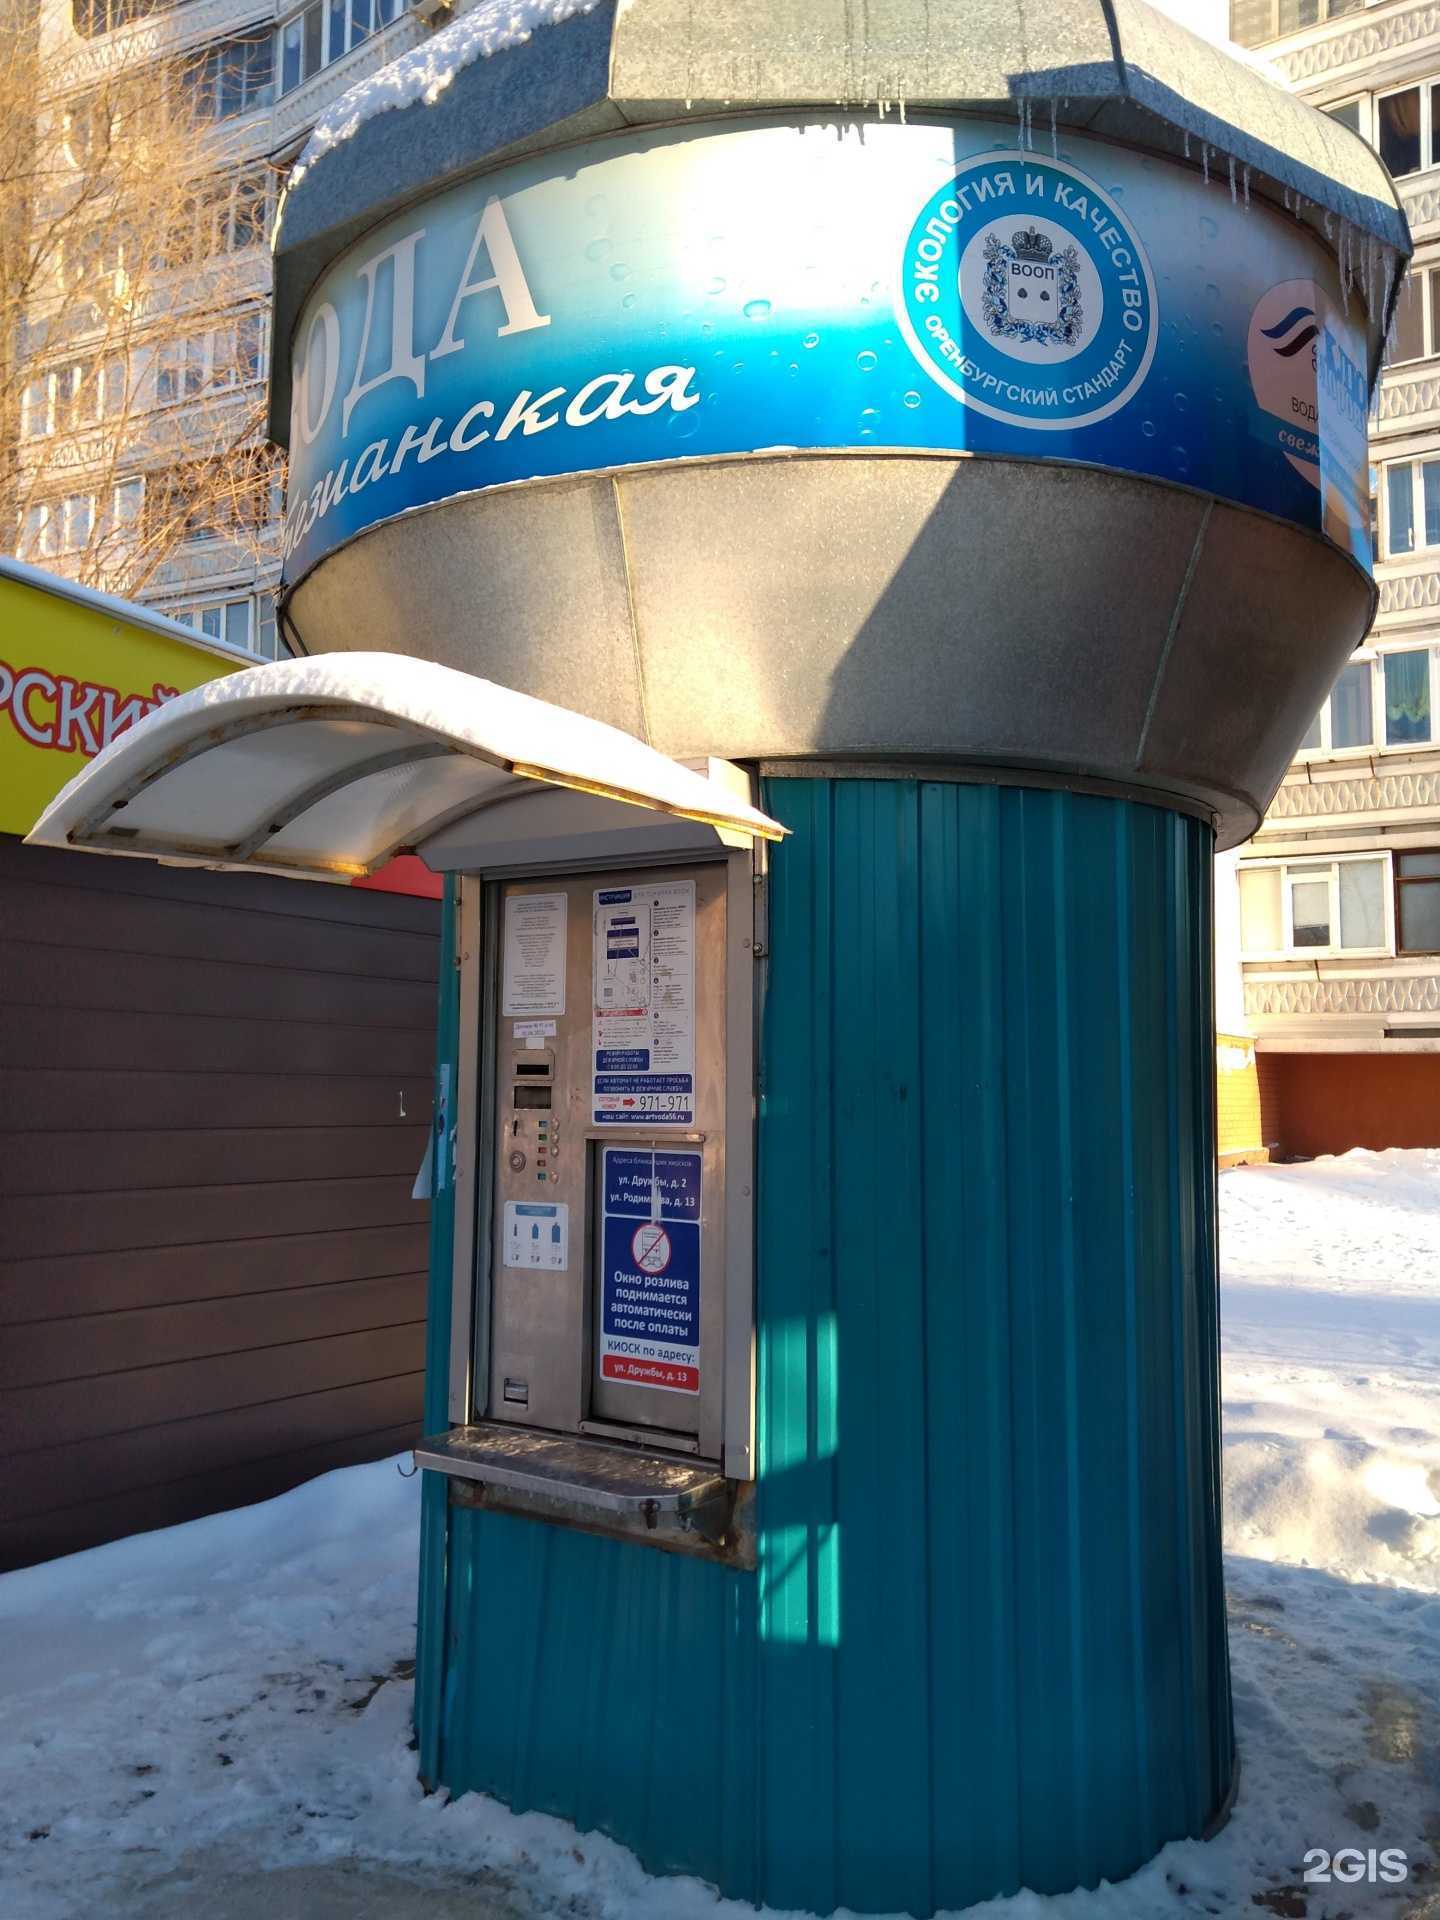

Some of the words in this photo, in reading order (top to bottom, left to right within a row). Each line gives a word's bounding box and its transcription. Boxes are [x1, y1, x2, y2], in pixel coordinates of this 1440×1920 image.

[913, 171, 1016, 304] ЭКОЛОГИЯ
[1025, 173, 1044, 197] И
[1053, 181, 1143, 332] КАЧЕСТВО
[1010, 262, 1055, 281] ВООП
[291, 194, 552, 446] ОДА
[925, 315, 1059, 406] ОРЕНБУРГСКИЙ
[1062, 339, 1134, 405] СТАНДАРТ
[1278, 429, 1320, 457] свеж
[283, 363, 700, 560] езианская
[639, 1095, 689, 1111] 971-971
[618, 1176, 630, 1186] ул.
[681, 1178, 687, 1188] 2
[610, 1193, 622, 1203] ул.
[685, 1197, 695, 1207] 13
[614, 1270, 642, 1285] Окно
[644, 1276, 690, 1290] розлива
[615, 1287, 688, 1305] поднимается
[610, 1302, 693, 1322] автоматически
[614, 1318, 646, 1331] после
[647, 1322, 689, 1337] оплаты
[607, 1339, 641, 1354] КИОСК
[643, 1346, 656, 1357] по
[657, 1348, 695, 1364] адресу:
[614, 1363, 626, 1373] ул.
[627, 1364, 666, 1380] Дружбы,
[677, 1371, 688, 1382] 13
